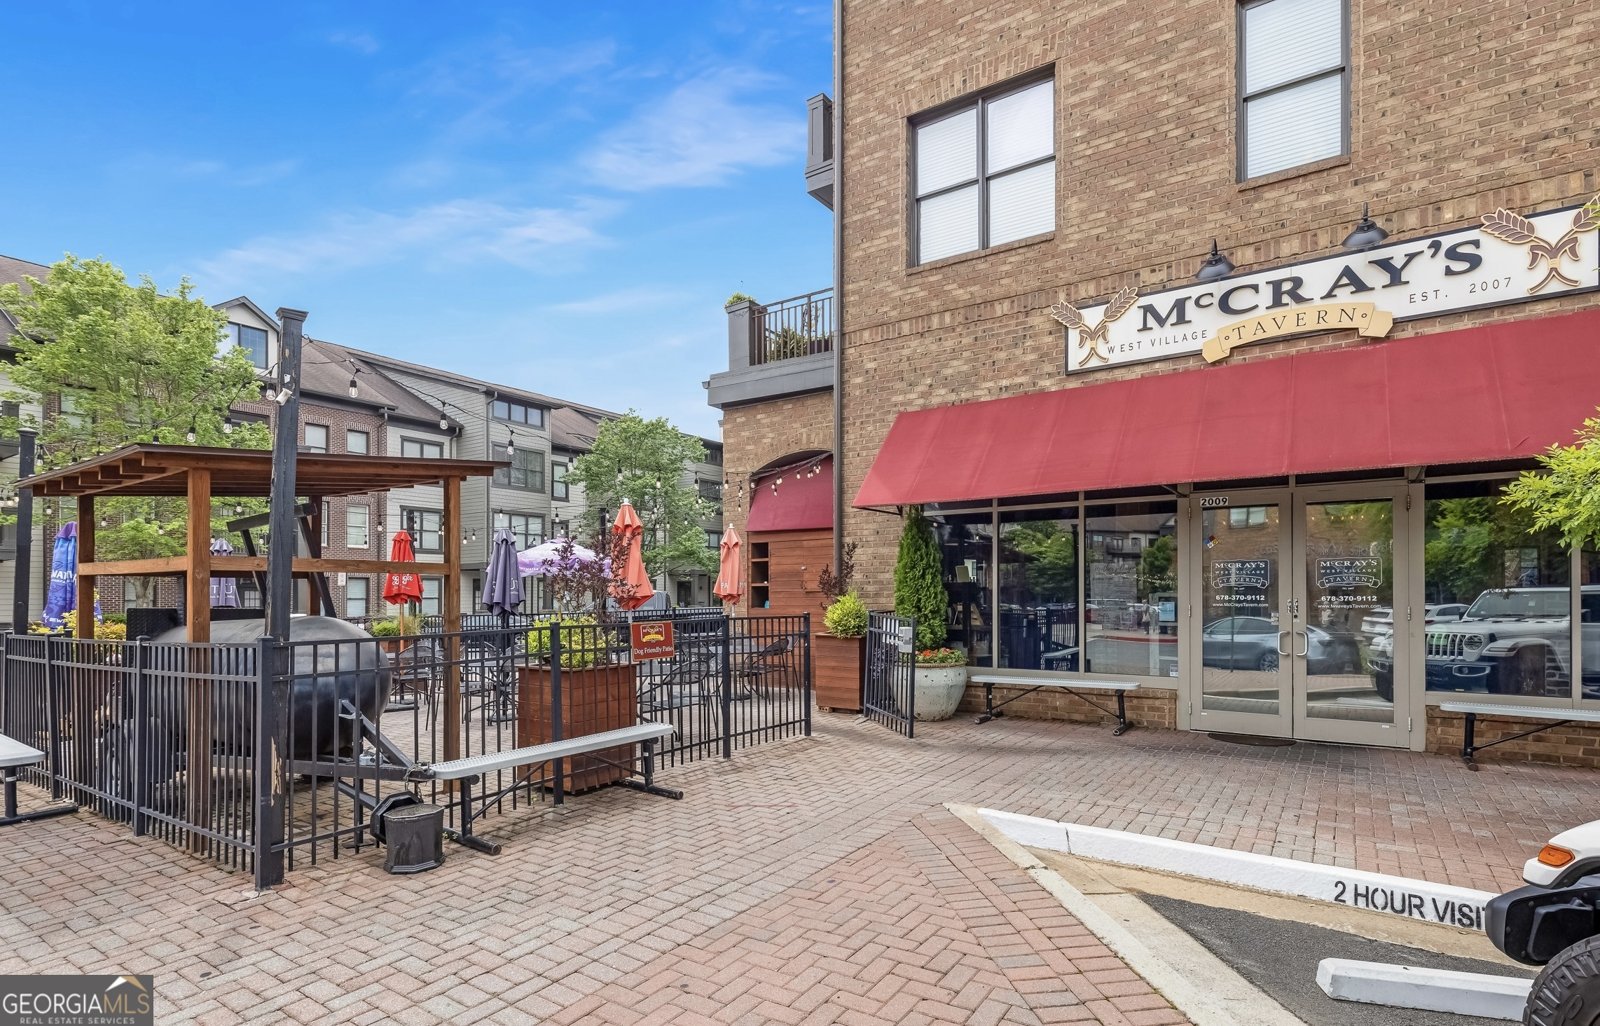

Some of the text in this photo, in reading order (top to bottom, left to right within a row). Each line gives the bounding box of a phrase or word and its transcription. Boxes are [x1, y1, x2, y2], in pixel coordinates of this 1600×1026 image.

[1408, 276, 1512, 304] EST. 2007
[1231, 307, 1358, 341] TAVERN
[1107, 329, 1208, 355] WEST VILLAGE
[1201, 497, 1228, 506] 2009
[634, 648, 644, 656] Dog
[644, 646, 662, 654] Friendly
[1334, 880, 1347, 904] 2
[1353, 883, 1425, 919] HOUR
